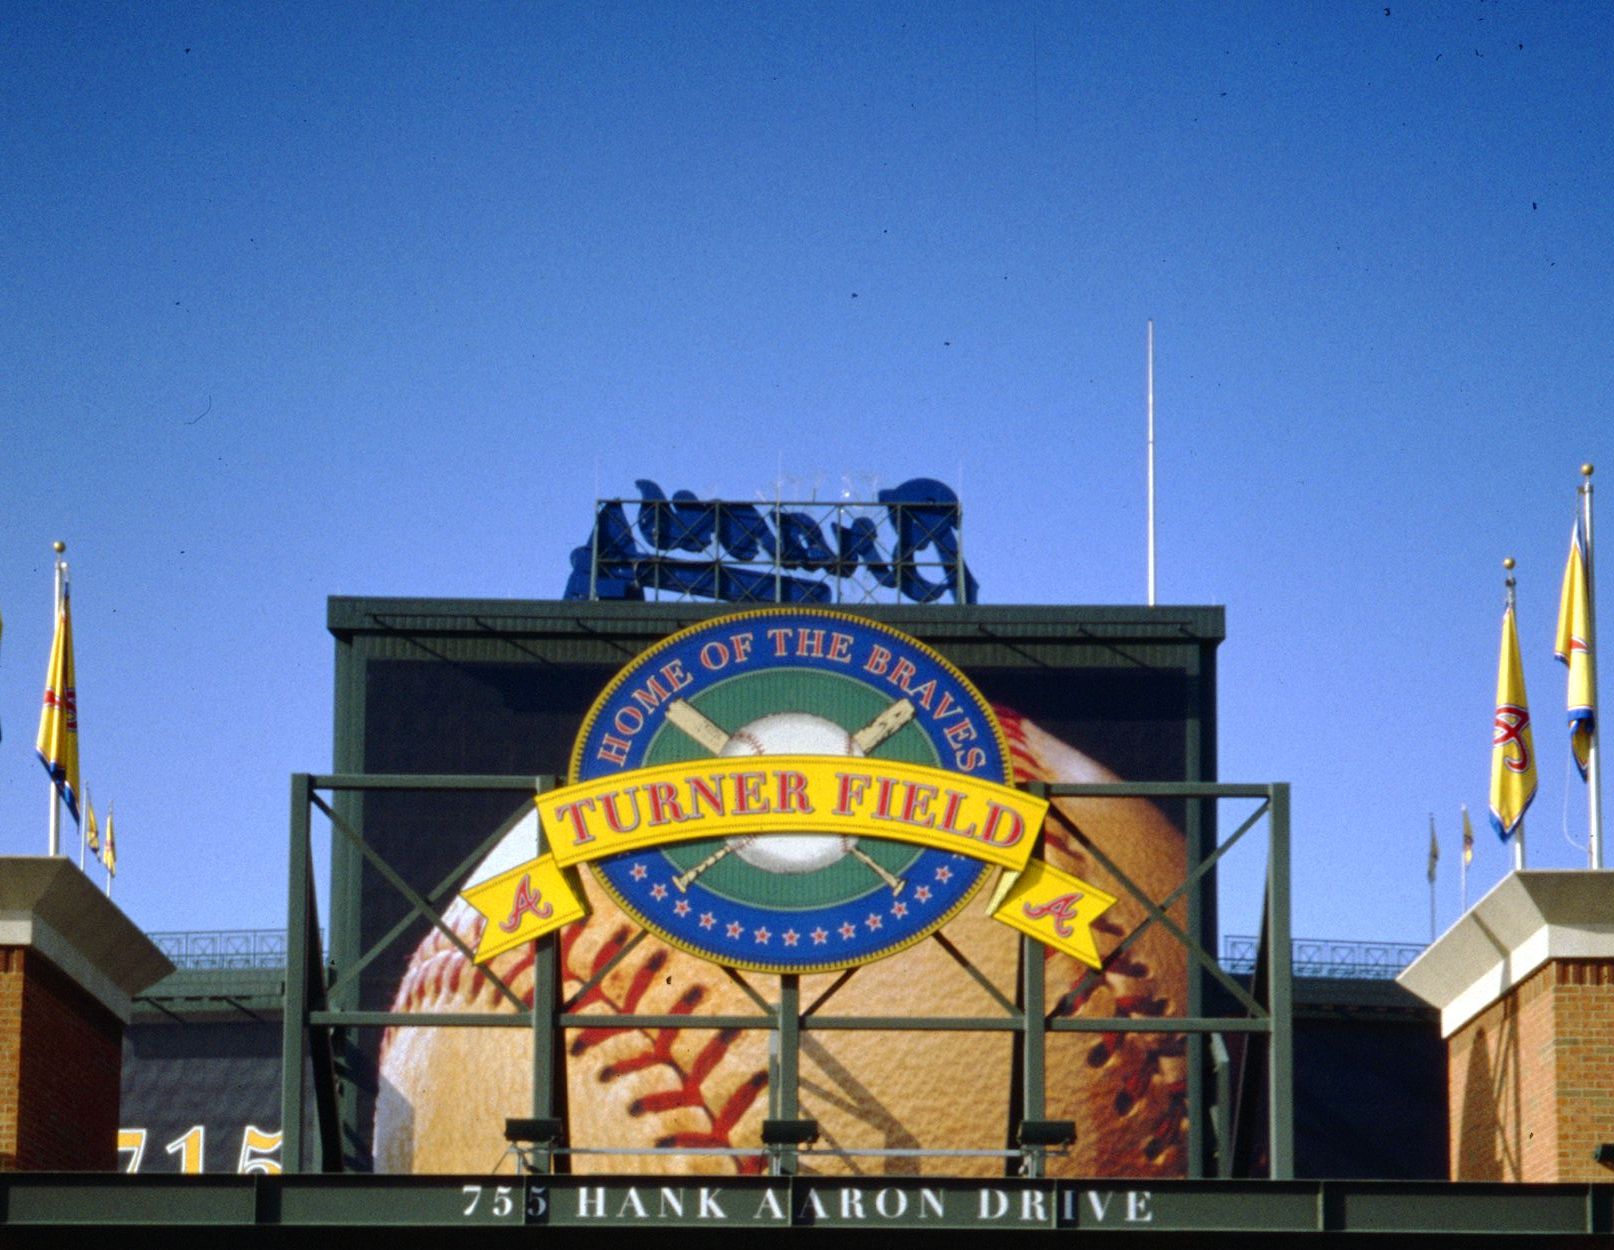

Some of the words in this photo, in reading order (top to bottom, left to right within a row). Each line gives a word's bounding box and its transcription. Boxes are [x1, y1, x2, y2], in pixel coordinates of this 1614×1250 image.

[597, 658, 694, 767] HOME
[700, 632, 754, 671] OF
[767, 628, 854, 663] THE
[862, 643, 987, 773] BRAVES
[555, 769, 813, 846] TURNER
[833, 771, 1025, 848] FIELD
[498, 873, 554, 934] A
[1022, 892, 1085, 938] A
[462, 1185, 546, 1217] 755
[576, 1186, 728, 1218] HANK
[753, 1187, 946, 1219] AARON
[977, 1187, 1153, 1222] DRIVE
